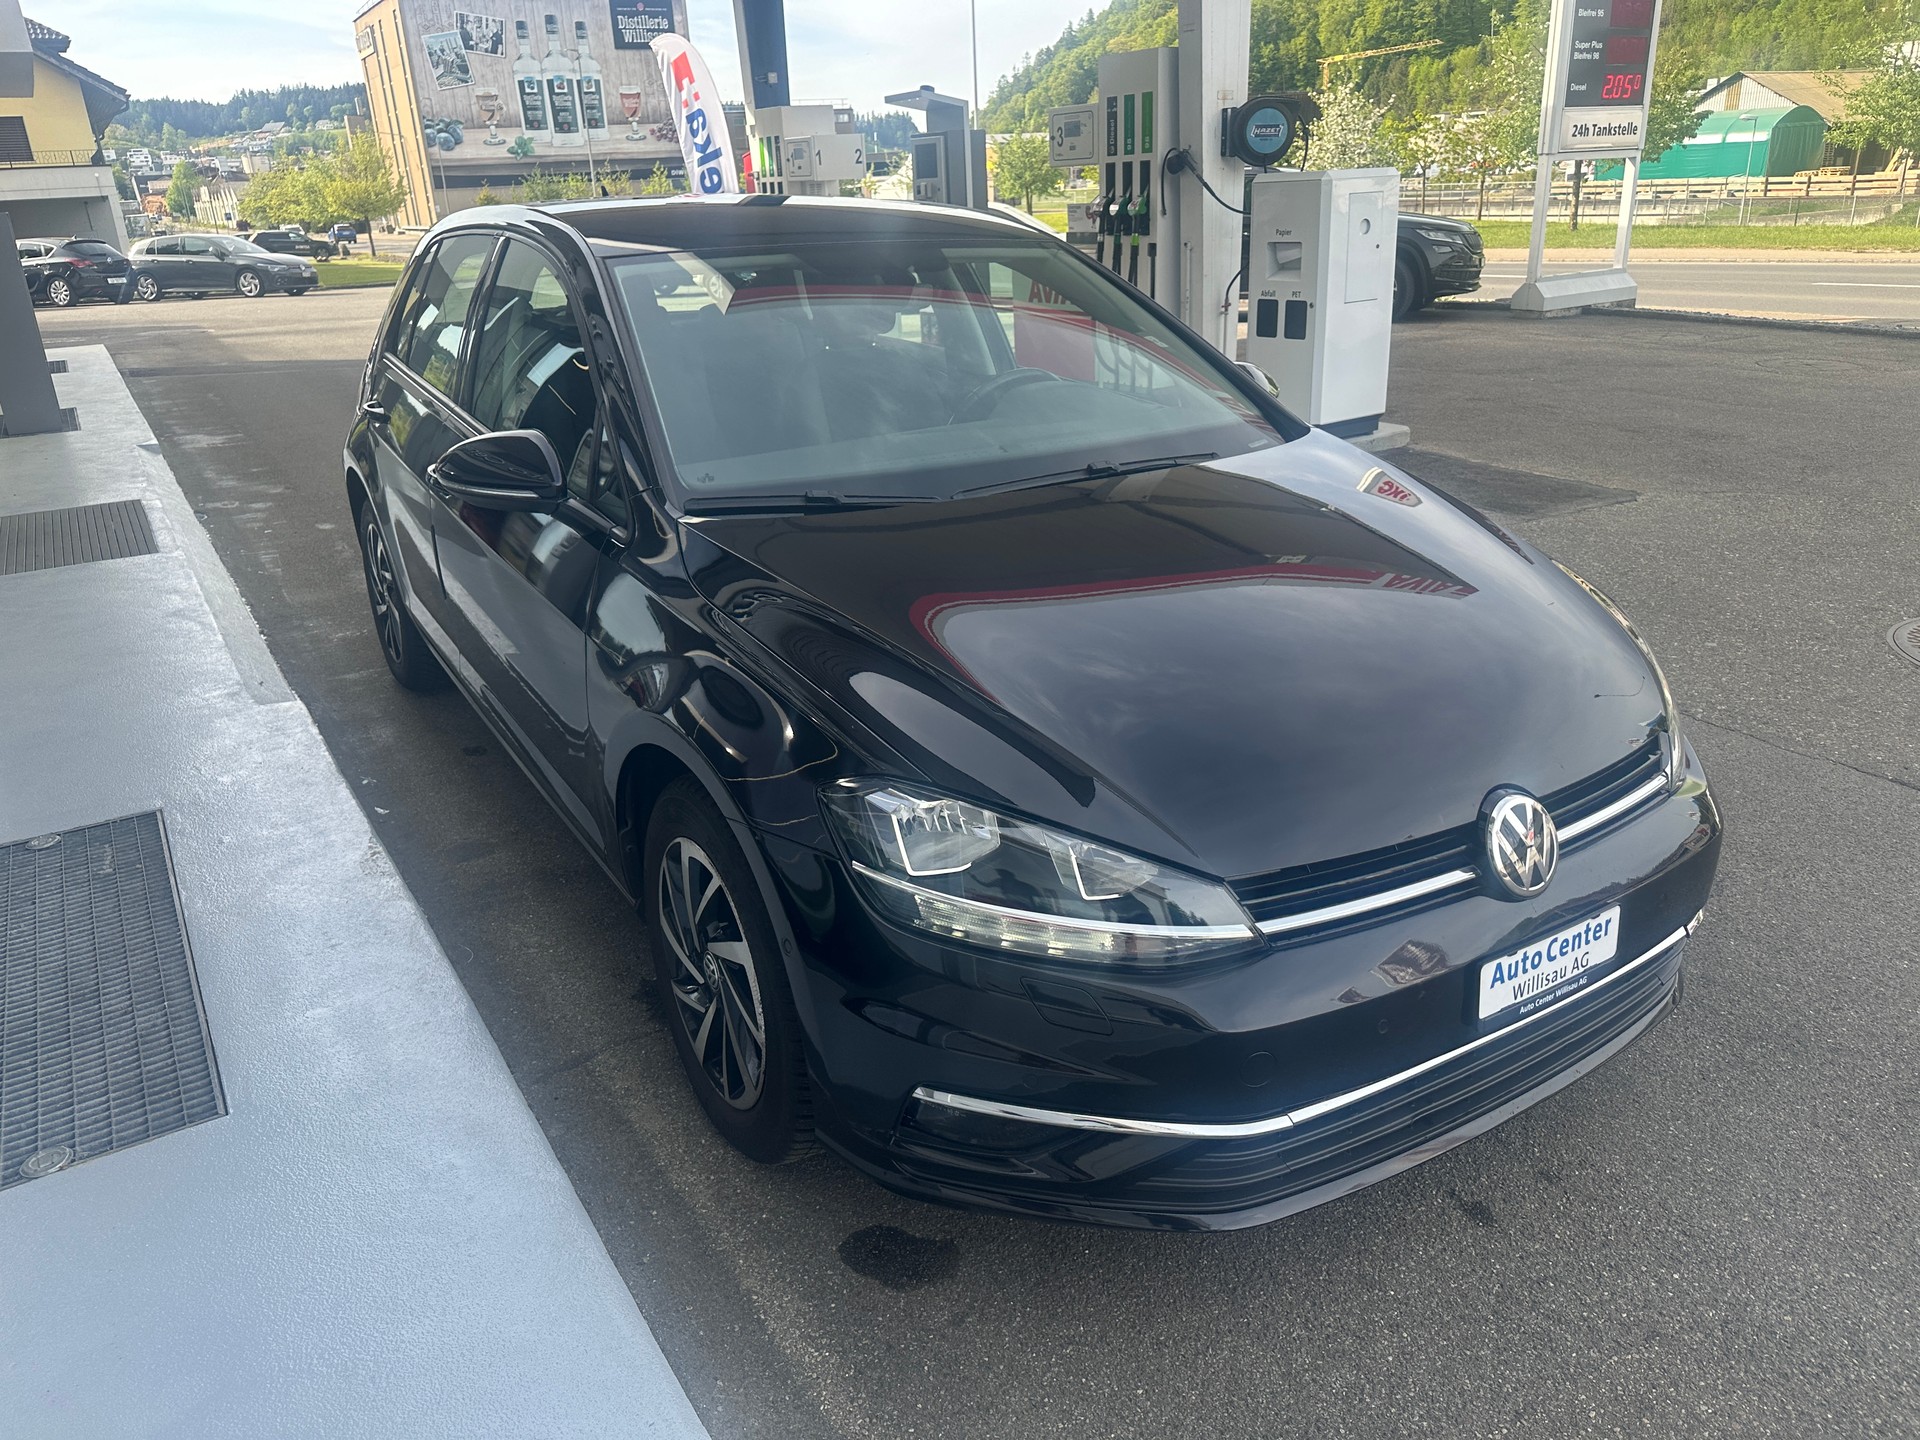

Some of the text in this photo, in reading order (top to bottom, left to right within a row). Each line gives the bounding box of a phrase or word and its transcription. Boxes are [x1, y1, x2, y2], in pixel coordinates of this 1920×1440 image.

[1578, 8, 1597, 17] Bleifrei
[617, 14, 669, 29] Distillerie
[622, 29, 664, 42] Willisa
[1574, 40, 1603, 50] Super Plus
[1573, 52, 1592, 60] Bleifrei
[1570, 83, 1587, 91] Diesel
[1056, 126, 1064, 147] 3
[1253, 127, 1280, 135] HAZET
[1571, 122, 1638, 137] 24h Tankstelle
[815, 149, 822, 166] 1
[854, 148, 863, 164] 2
[1275, 228, 1292, 238] Papier
[1028, 280, 1071, 304] AVI
[1512, 951, 1589, 1001] Willisau AG
[1520, 976, 1588, 1014] Auto Center Willisau AG
